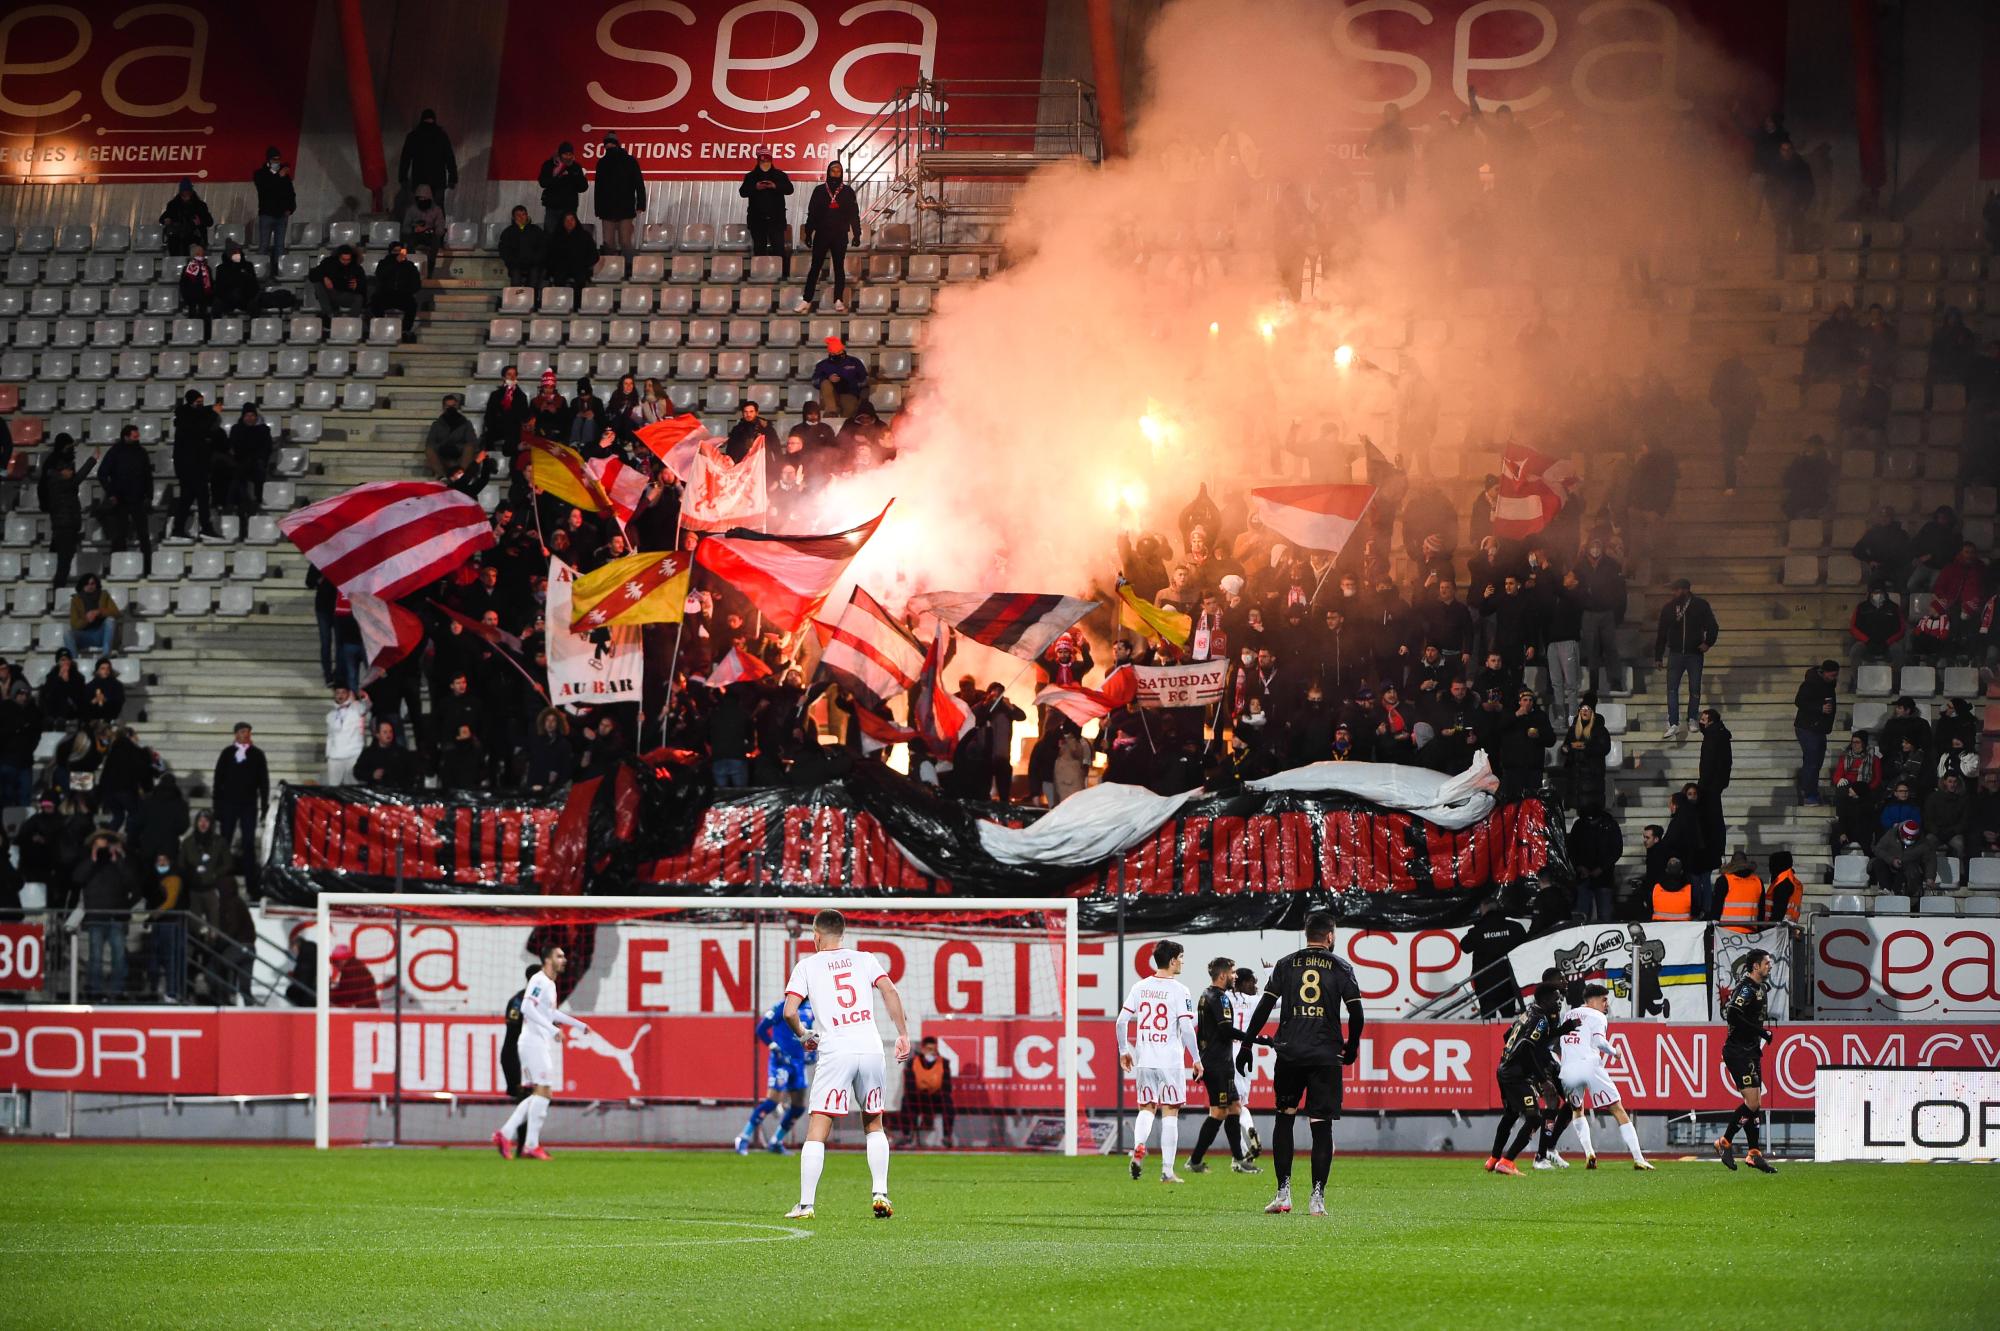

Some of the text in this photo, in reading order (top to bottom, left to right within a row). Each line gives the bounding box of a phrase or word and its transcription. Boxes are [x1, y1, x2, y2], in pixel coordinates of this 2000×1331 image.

[587, 0, 949, 114] sea
[593, 678, 634, 694] BAR
[1138, 672, 1221, 690] SATURDAY
[1168, 691, 1189, 702] FC
[827, 958, 853, 971] HAAG
[1292, 955, 1333, 970] LE BIHAN
[1817, 928, 2000, 1003] sea
[833, 971, 857, 1009] 5
[1141, 989, 1169, 1000] DEWAELE
[1299, 969, 1321, 1004] 8
[841, 1009, 871, 1025] LCR
[1139, 1001, 1169, 1031] 28
[1302, 1006, 1325, 1017] LCR
[983, 1035, 1096, 1080] LCR
[1359, 1037, 1473, 1083] LCR
[1345, 1086, 1473, 1094] ONSTRUCTEURS REUNIS
